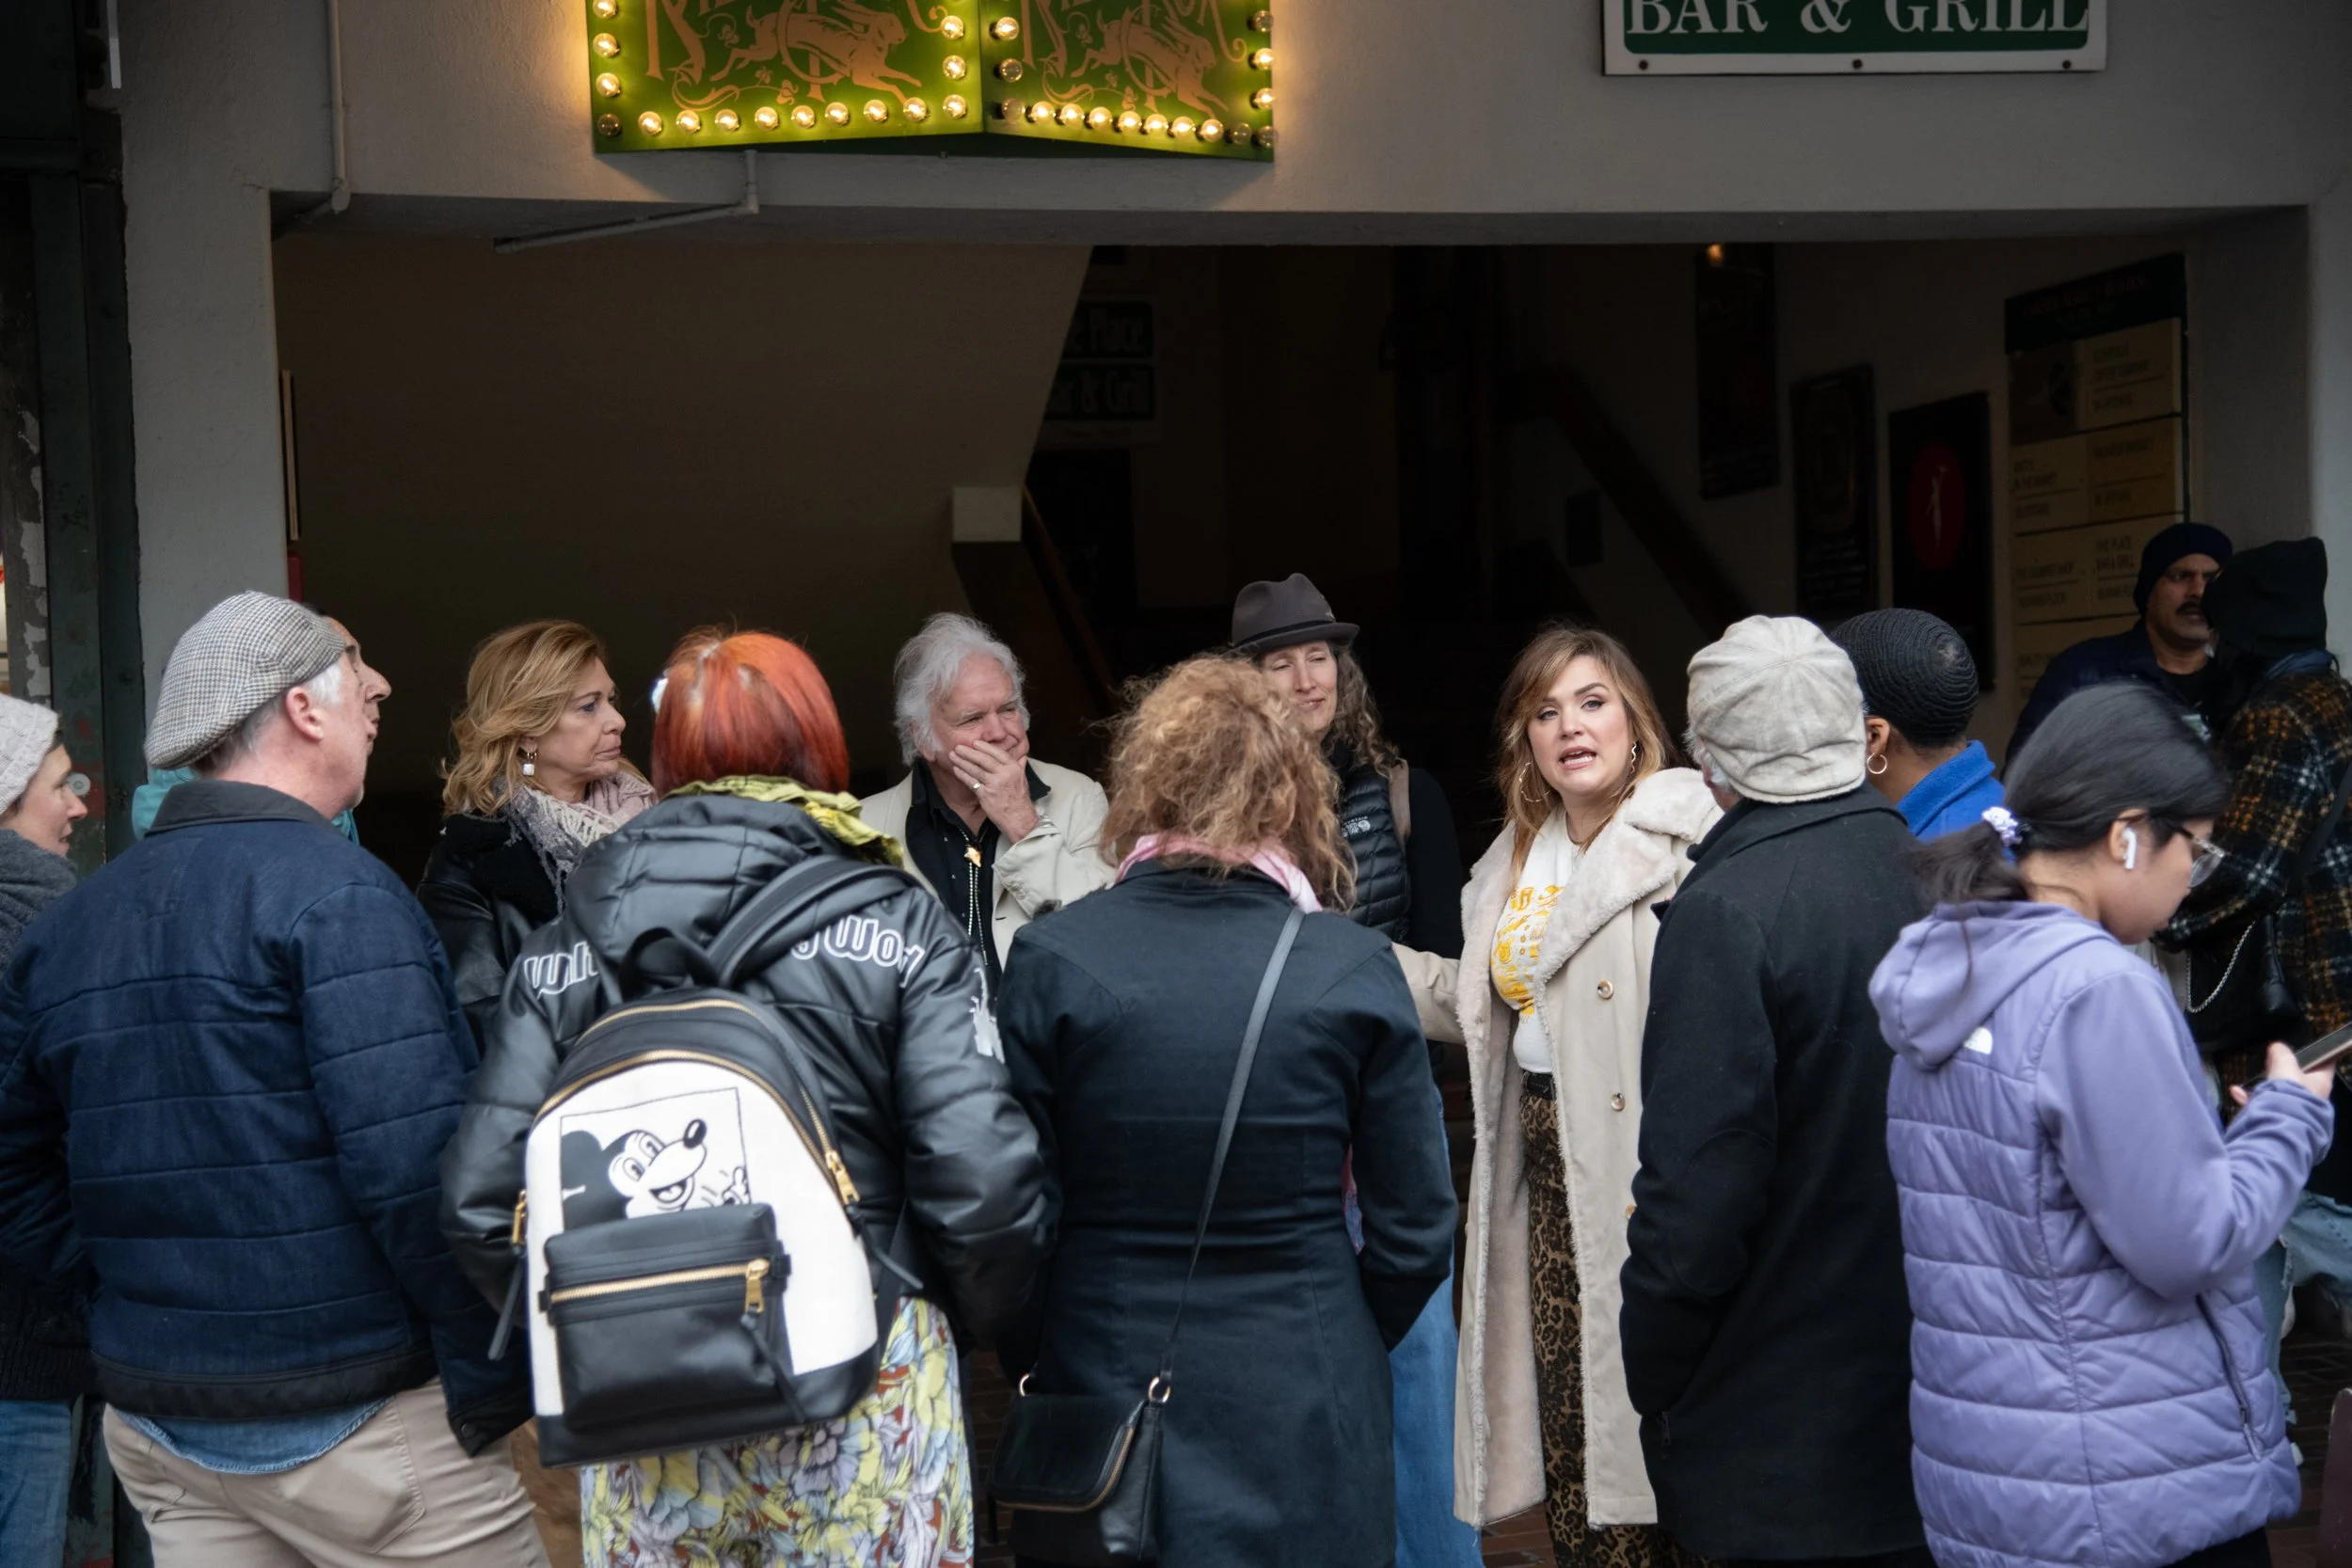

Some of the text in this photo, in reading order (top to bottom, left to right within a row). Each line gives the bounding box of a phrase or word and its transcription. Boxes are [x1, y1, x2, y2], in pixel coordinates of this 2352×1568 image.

[1627, 0, 2089, 34] BAR & GRILL
